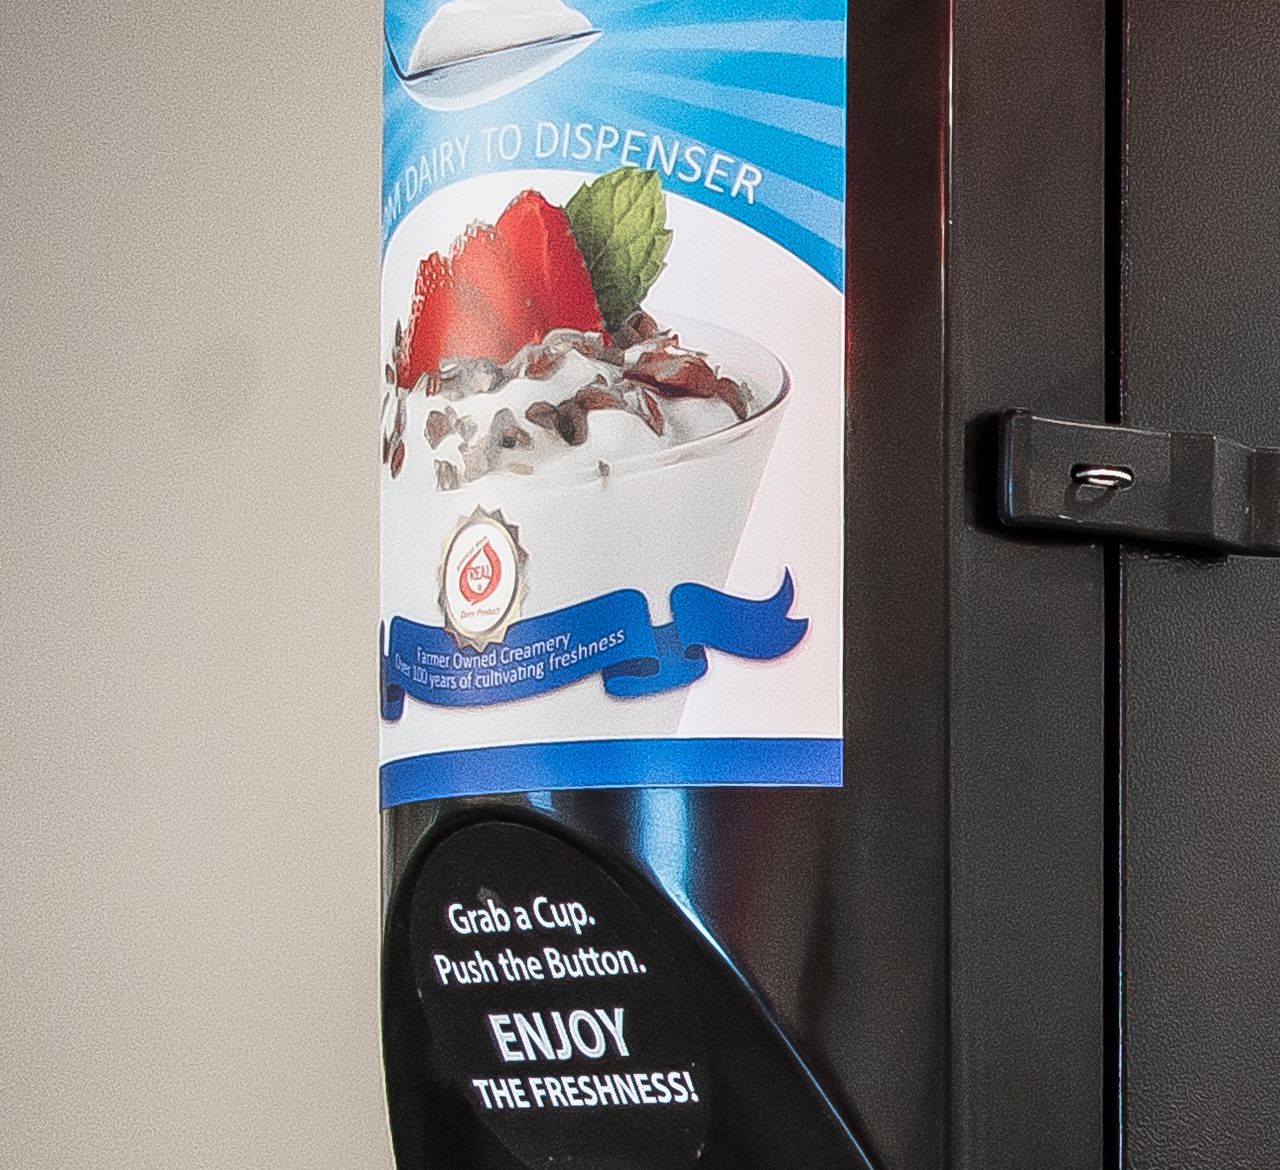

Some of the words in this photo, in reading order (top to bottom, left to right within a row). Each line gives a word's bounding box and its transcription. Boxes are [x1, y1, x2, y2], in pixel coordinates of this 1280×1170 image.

[405, 133, 470, 202] DAIRY
[481, 123, 522, 165] TO
[535, 121, 764, 206] DISPENSER
[416, 646, 451, 669] Farmer
[452, 649, 497, 670] Owned
[499, 632, 572, 666] Creamery
[429, 673, 458, 690] years
[458, 671, 474, 690] of
[474, 660, 546, 688] cultivating
[548, 628, 626, 672] freshness
[447, 899, 511, 935] Grab
[514, 904, 533, 931] a
[532, 895, 597, 936] Cup.
[433, 950, 500, 986] Push
[498, 947, 545, 982] the
[543, 946, 648, 979] Button.
[487, 1007, 631, 1063] ENJOY
[472, 1078, 532, 1110] THE
[530, 1071, 700, 1108] FRESHNESS!
